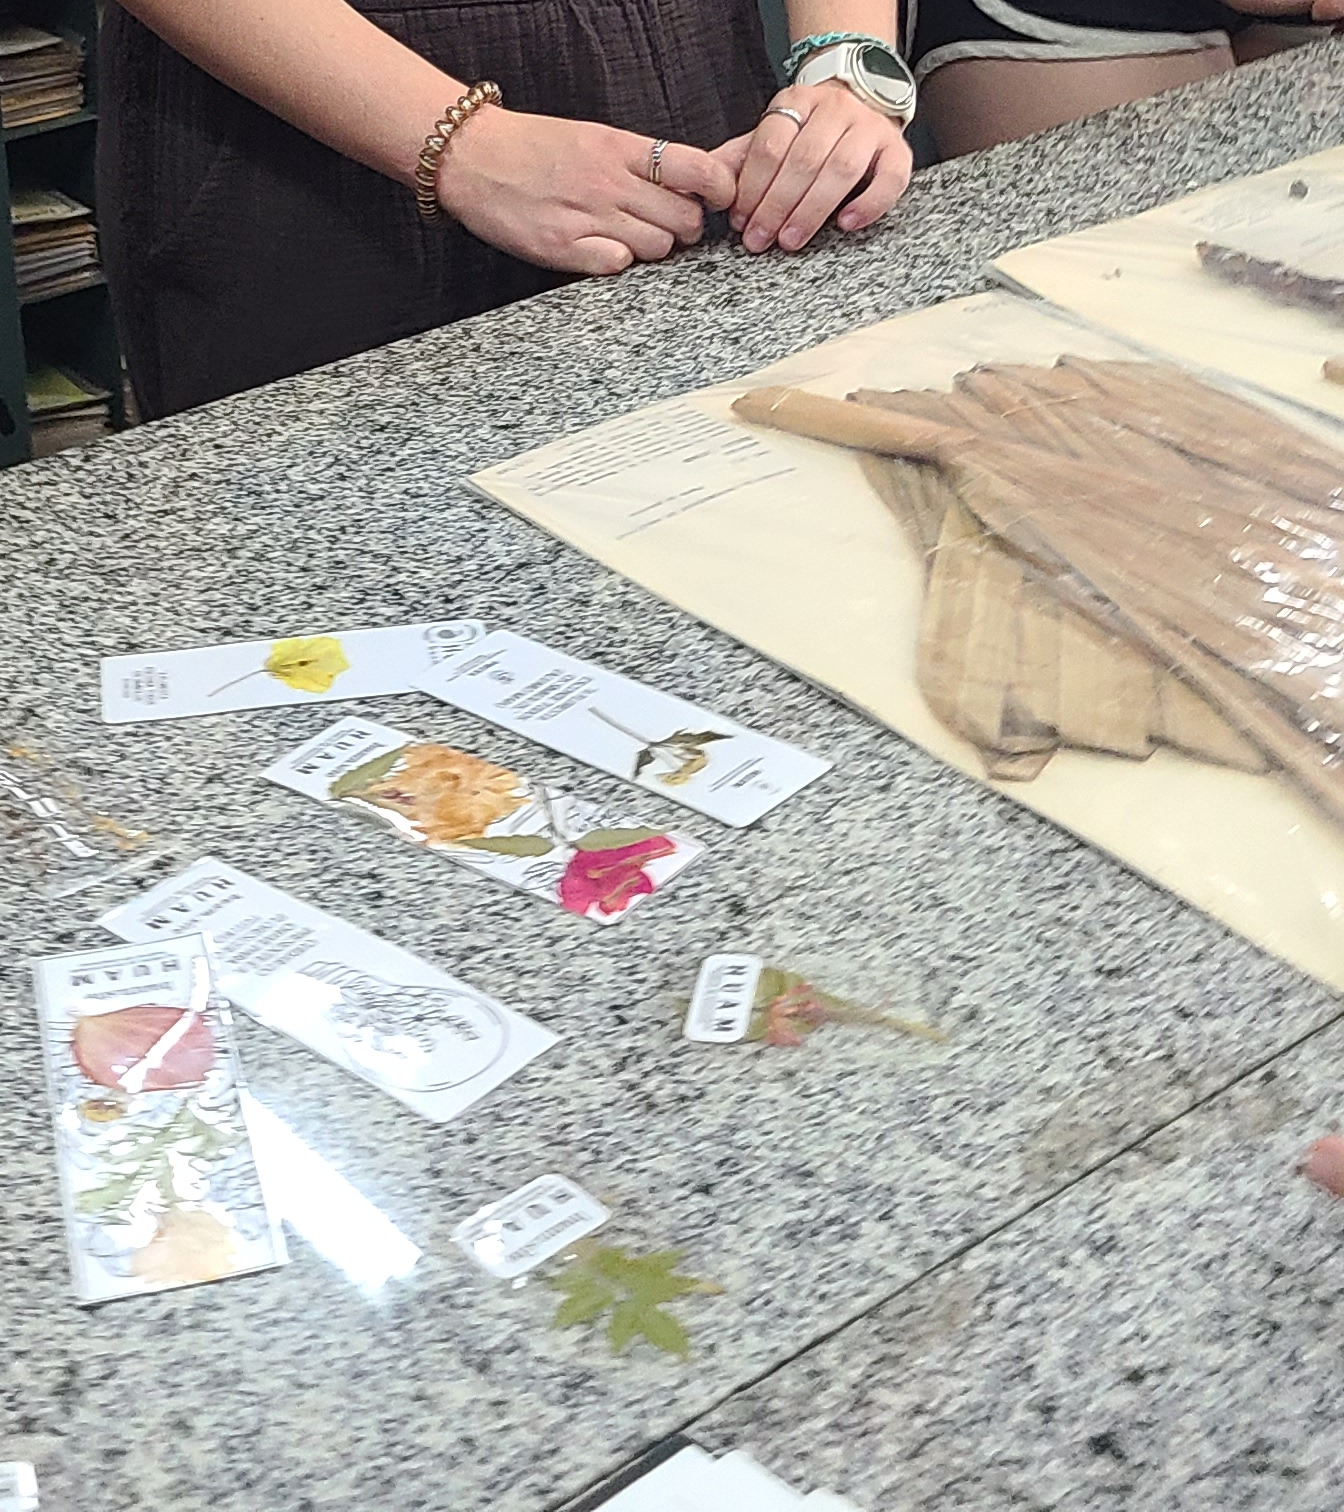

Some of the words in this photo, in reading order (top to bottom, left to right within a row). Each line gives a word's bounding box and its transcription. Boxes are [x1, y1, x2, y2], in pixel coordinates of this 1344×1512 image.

[296, 730, 372, 775] HUAM
[144, 878, 236, 929] HUAM
[69, 959, 181, 987] HUAM
[712, 964, 748, 1032] HUAM
[472, 1188, 576, 1255] HUA
